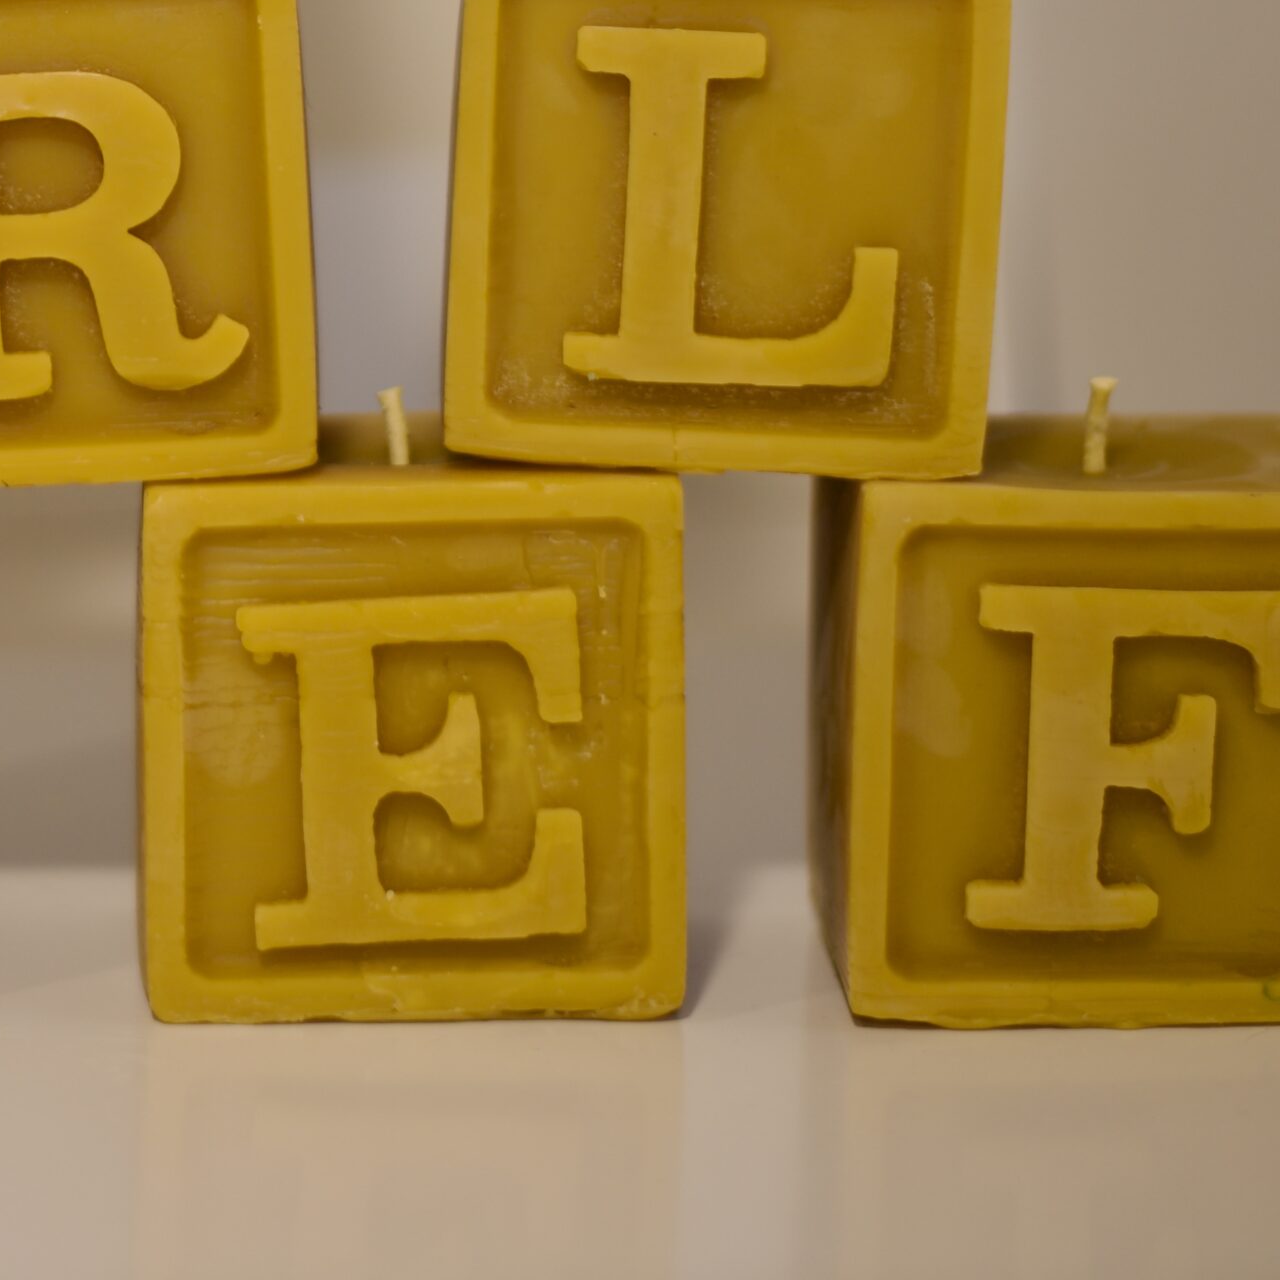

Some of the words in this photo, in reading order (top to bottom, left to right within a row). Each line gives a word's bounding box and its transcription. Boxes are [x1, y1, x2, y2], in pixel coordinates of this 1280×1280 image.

[562, 25, 899, 387] L
[235, 589, 585, 949] E
[965, 584, 1280, 932] F
